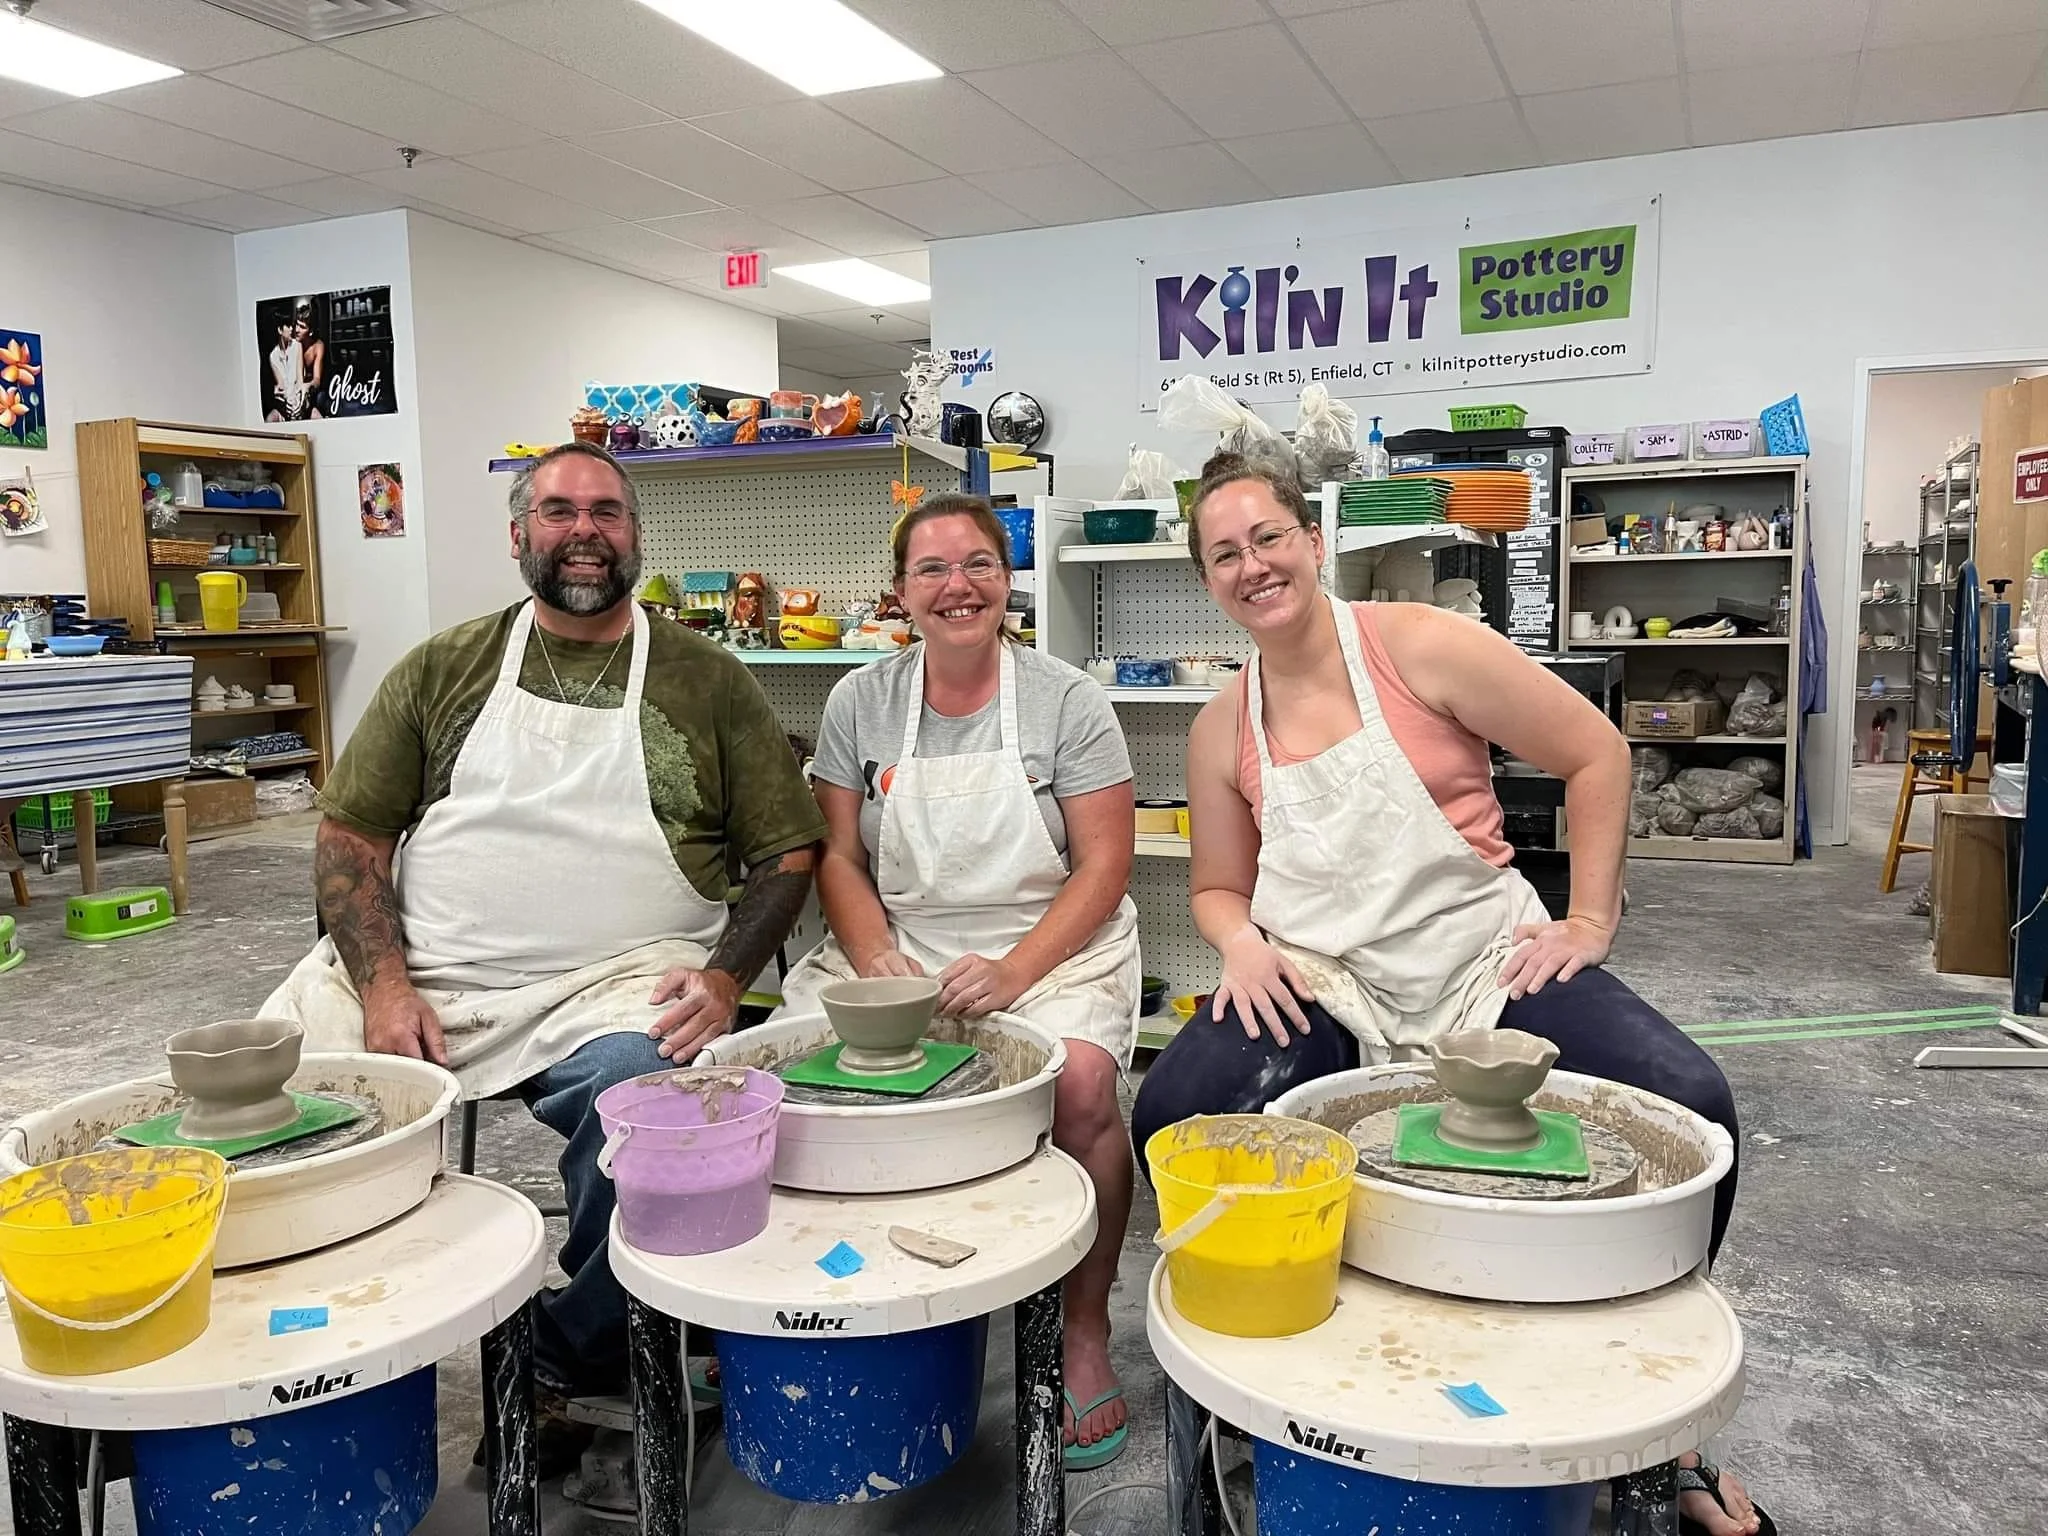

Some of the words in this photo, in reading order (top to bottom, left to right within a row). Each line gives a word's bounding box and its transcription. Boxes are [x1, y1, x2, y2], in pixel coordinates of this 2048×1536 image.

[727, 254, 759, 288] EXIT
[1472, 243, 1624, 284] Pottery
[1365, 255, 1438, 343] It
[1480, 278, 1609, 320] Studio
[950, 347, 978, 361] Rest
[1244, 373, 1259, 386] St
[1264, 371, 1283, 387] (Rt
[1288, 369, 1305, 385] 5),
[1311, 364, 1367, 381] Enfield,
[1372, 361, 1394, 376] CT
[1422, 343, 1626, 372] kilnitpotterystudio.com
[951, 361, 993, 375] Rooms
[1574, 443, 1615, 454] COLLETTE
[1647, 436, 1666, 446] SAM
[1708, 429, 1743, 441] ASTRID
[2025, 476, 2042, 492] ONLY
[772, 1310, 854, 1331] Nidec
[268, 1369, 364, 1407] Nidec
[1283, 1420, 1377, 1464] Nidec
